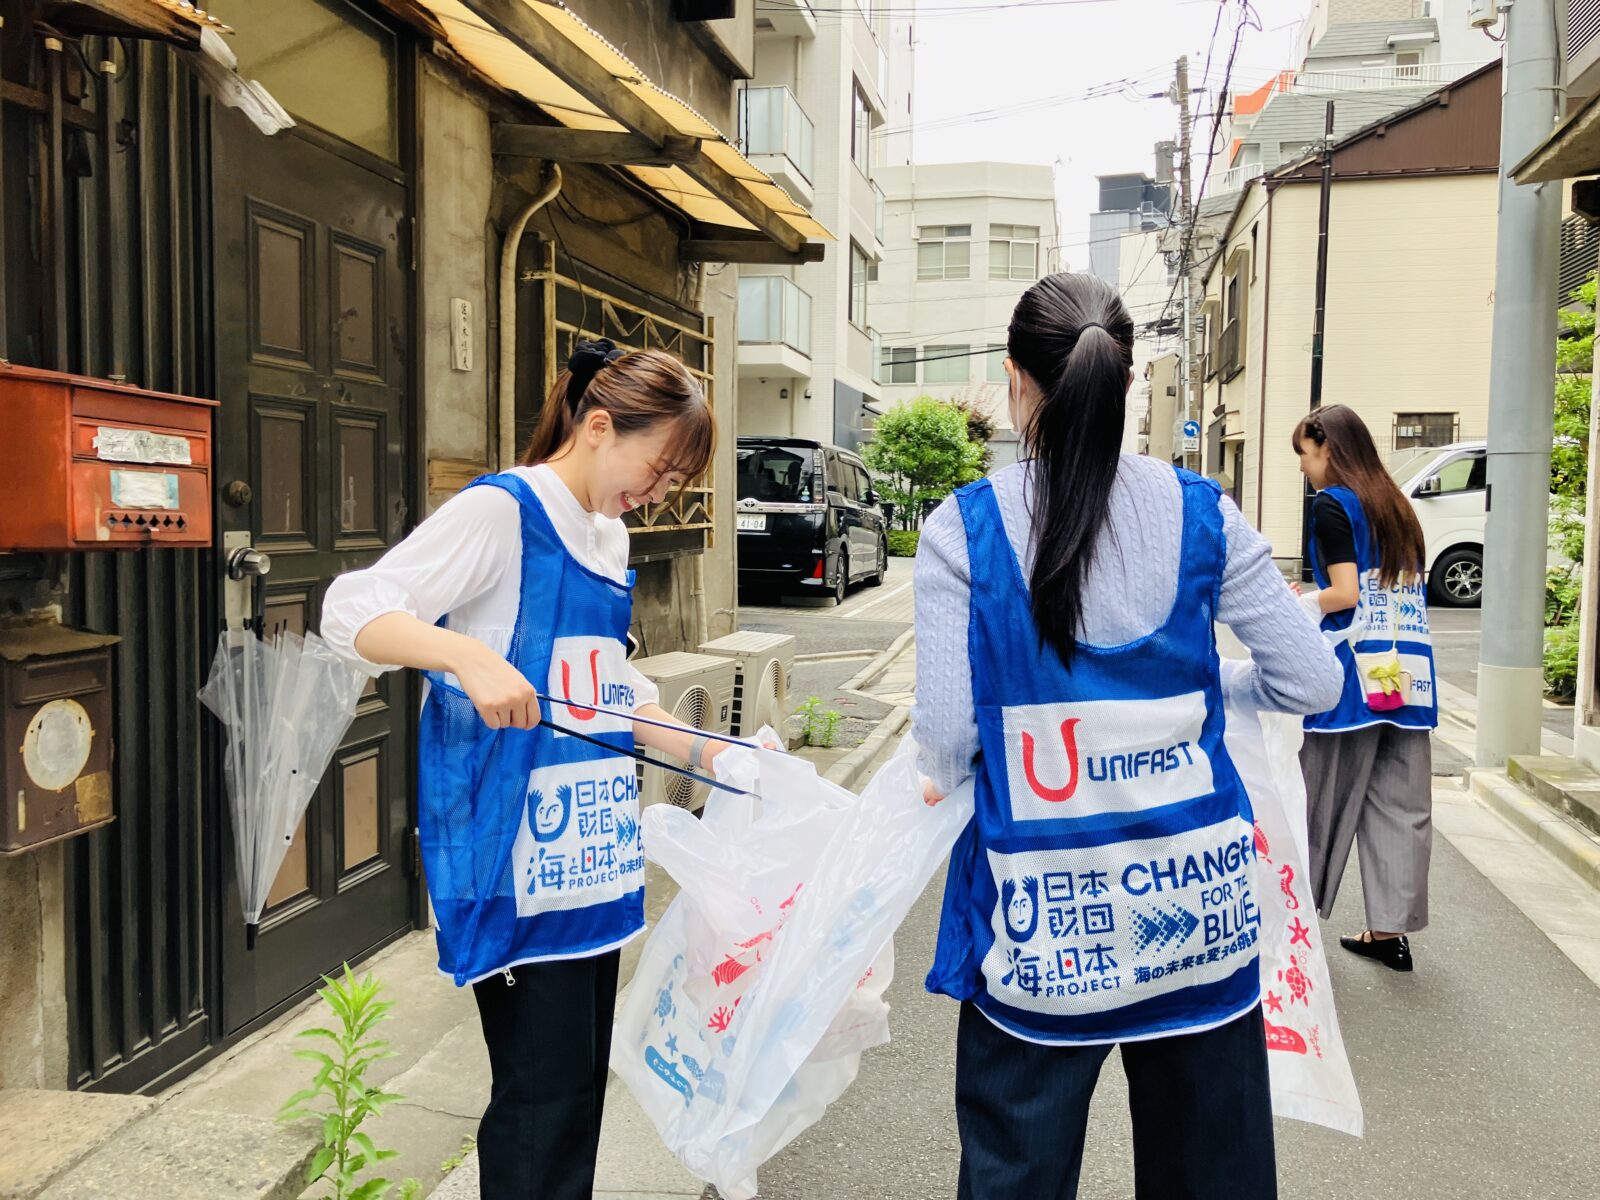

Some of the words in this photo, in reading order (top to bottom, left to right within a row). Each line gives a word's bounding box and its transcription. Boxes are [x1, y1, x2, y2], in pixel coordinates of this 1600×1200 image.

[1086, 741, 1194, 782] UNIFAST
[1121, 834, 1251, 897] CHANGE
[1042, 869, 1110, 903] 日本
[1201, 882, 1244, 910] FOR
[1047, 902, 1116, 939] 財団
[1203, 890, 1260, 947] BLUE
[1045, 975, 1121, 998] PROJECT
